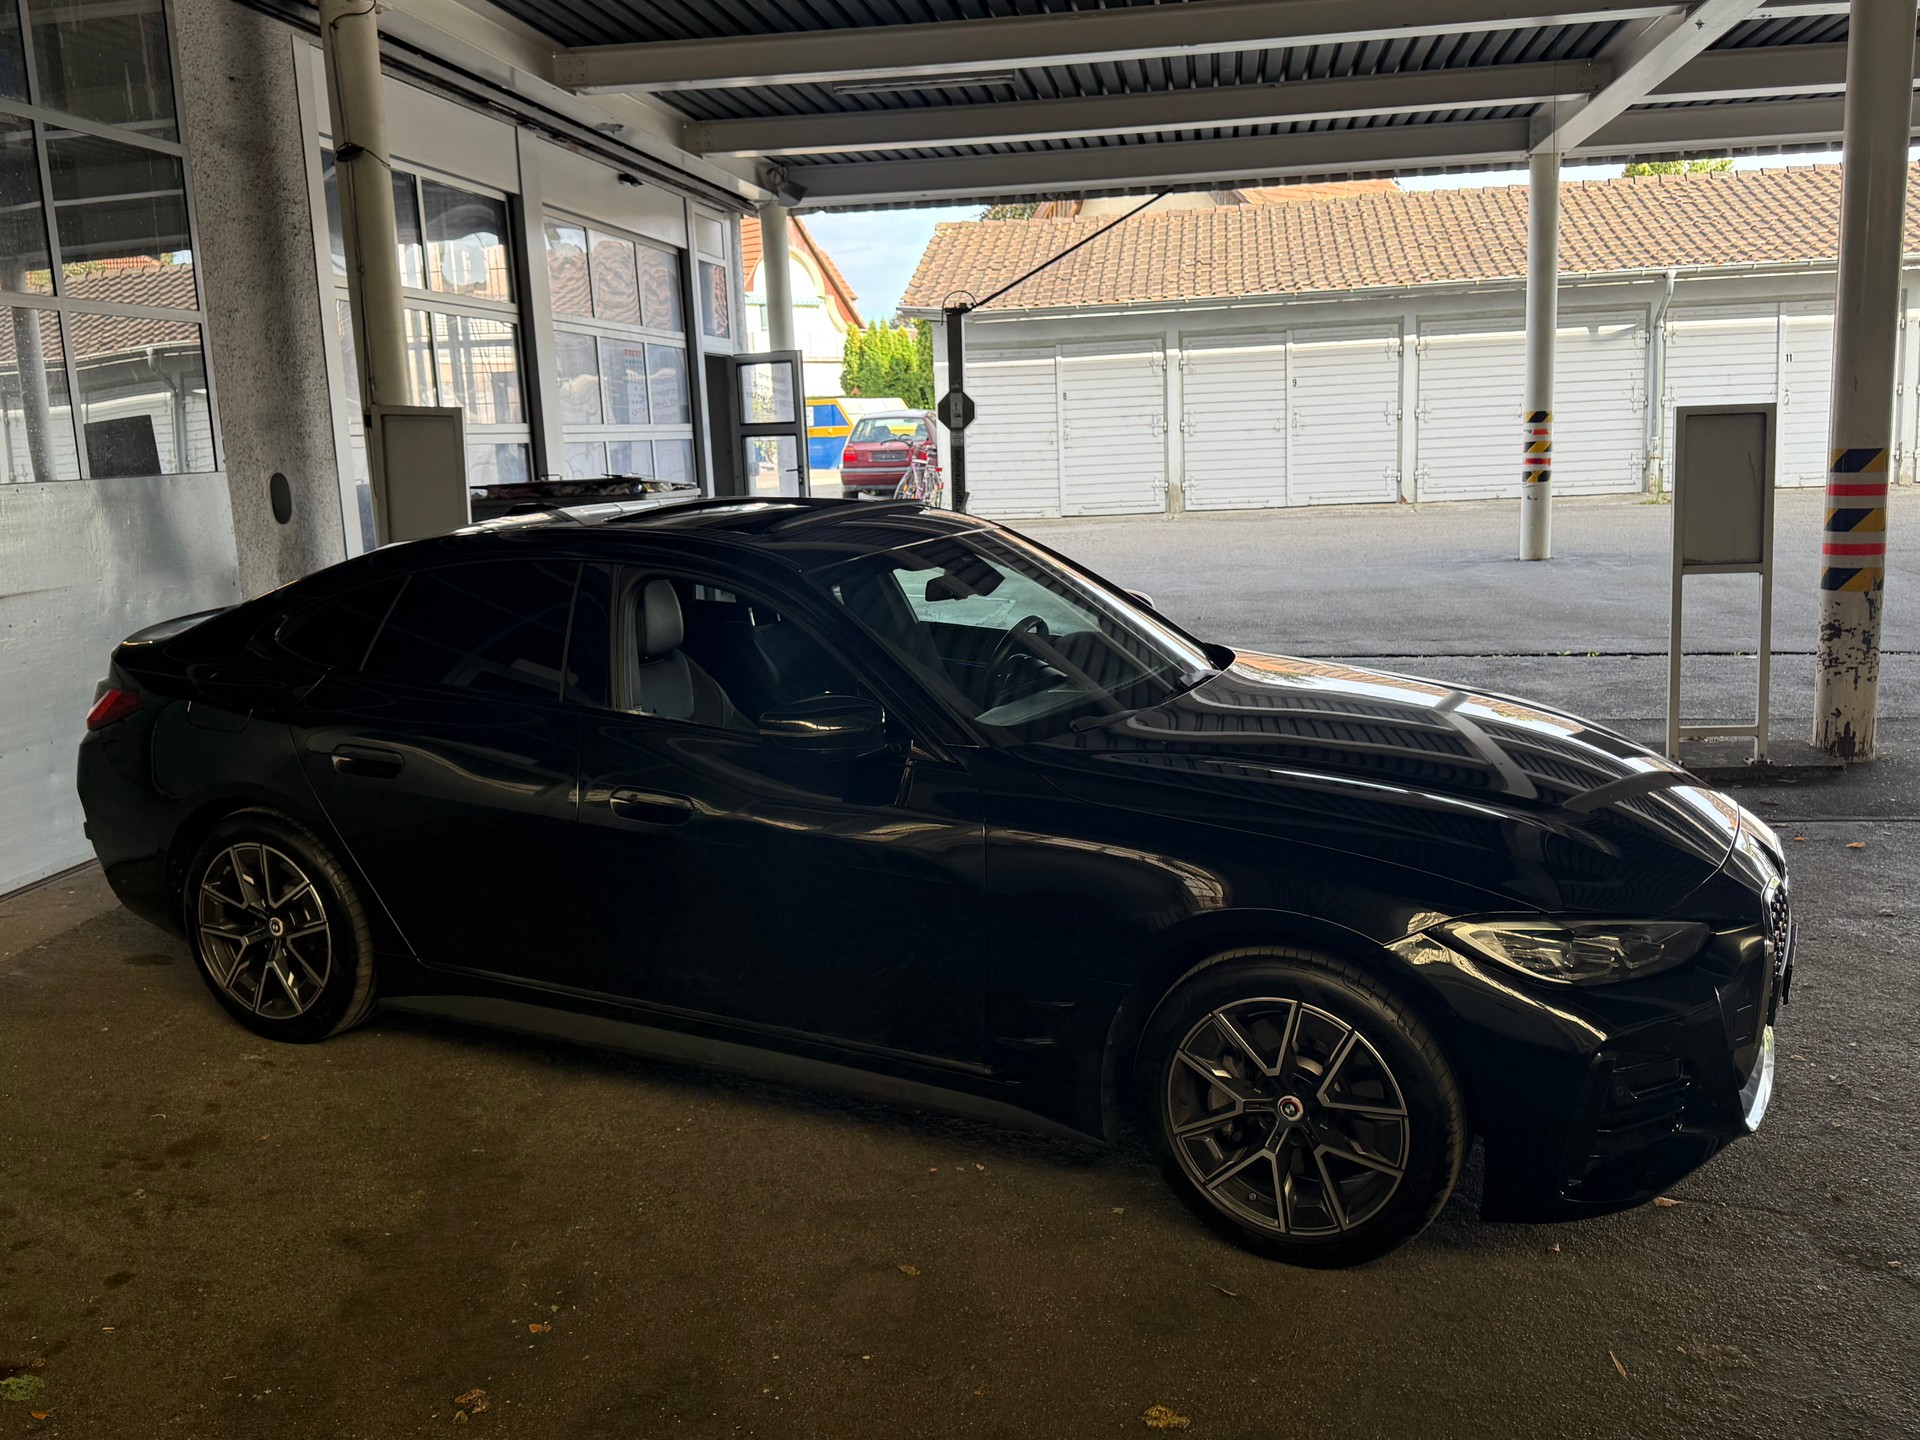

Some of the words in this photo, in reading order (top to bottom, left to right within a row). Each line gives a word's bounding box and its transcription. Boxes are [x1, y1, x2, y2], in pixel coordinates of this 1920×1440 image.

[1785, 353, 1792, 363] 11
[1292, 379, 1297, 388] 9
[1062, 392, 1067, 401] 8
